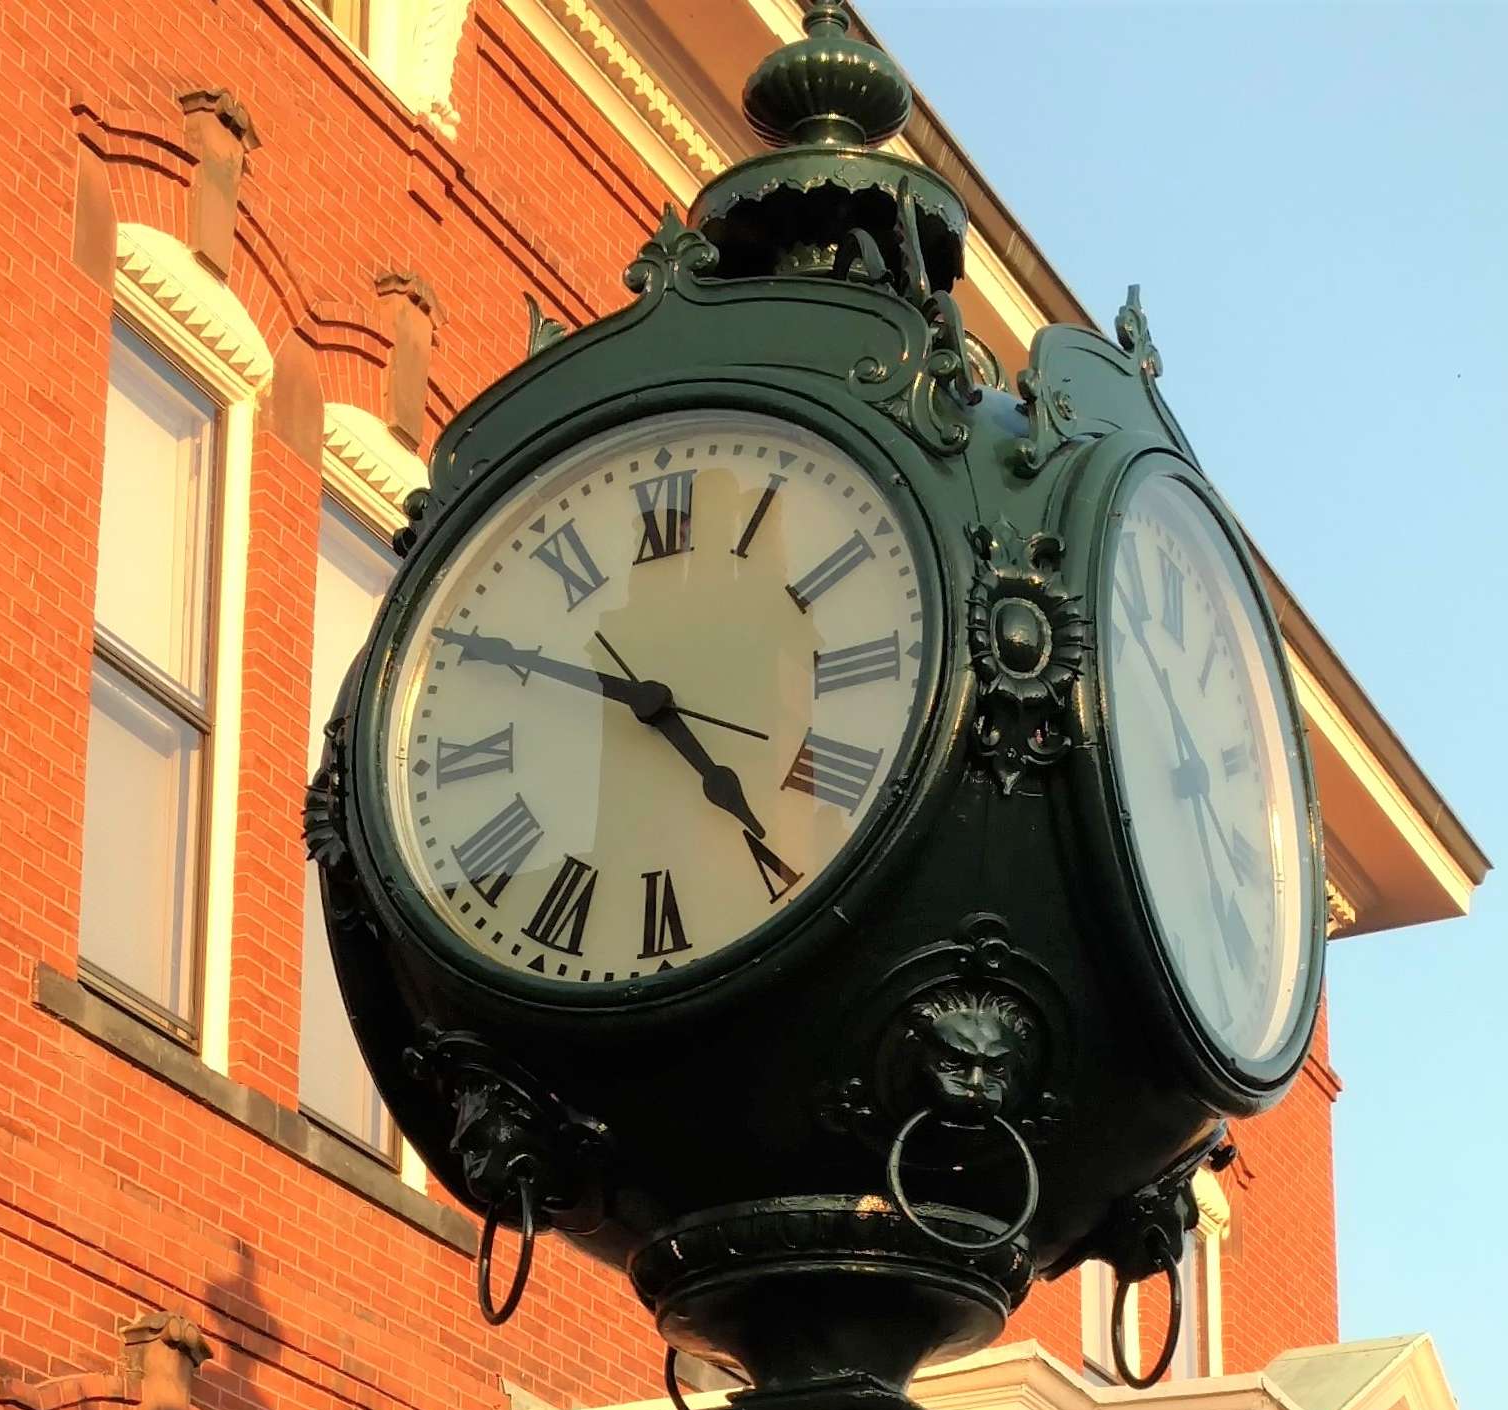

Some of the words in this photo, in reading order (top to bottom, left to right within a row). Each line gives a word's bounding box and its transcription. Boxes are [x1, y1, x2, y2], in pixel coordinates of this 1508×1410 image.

[629, 468, 698, 566] XII
[528, 517, 610, 613] XI
[785, 528, 877, 615] II
[812, 629, 901, 700] III
[436, 721, 514, 790] IX
[450, 791, 545, 909] VIII
[742, 828, 806, 904] V
[520, 852, 599, 957] VII
[636, 868, 694, 960] VI
